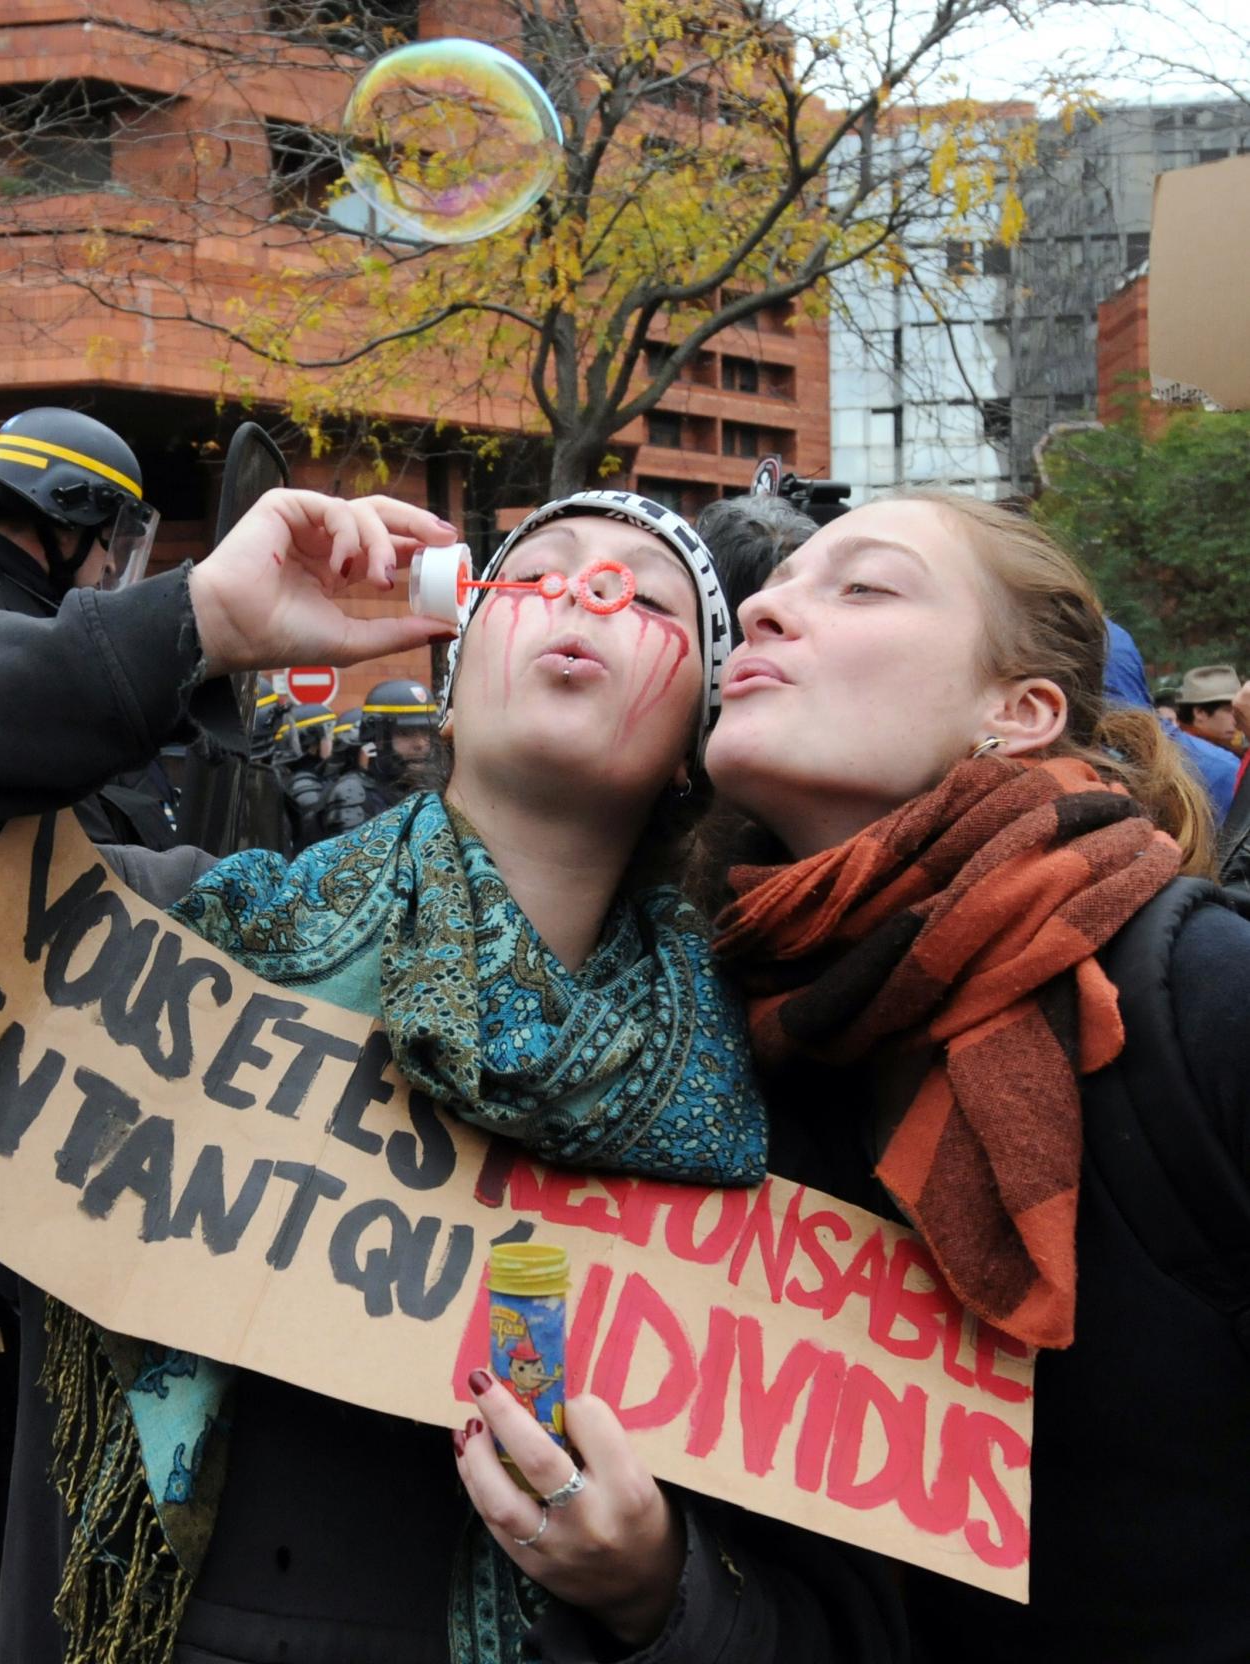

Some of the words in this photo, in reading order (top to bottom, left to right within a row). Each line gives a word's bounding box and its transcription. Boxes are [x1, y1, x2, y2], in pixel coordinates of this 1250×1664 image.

[23, 809, 233, 1081] VOUS
[201, 992, 458, 1191] ETES
[54, 1065, 347, 1271] TANT
